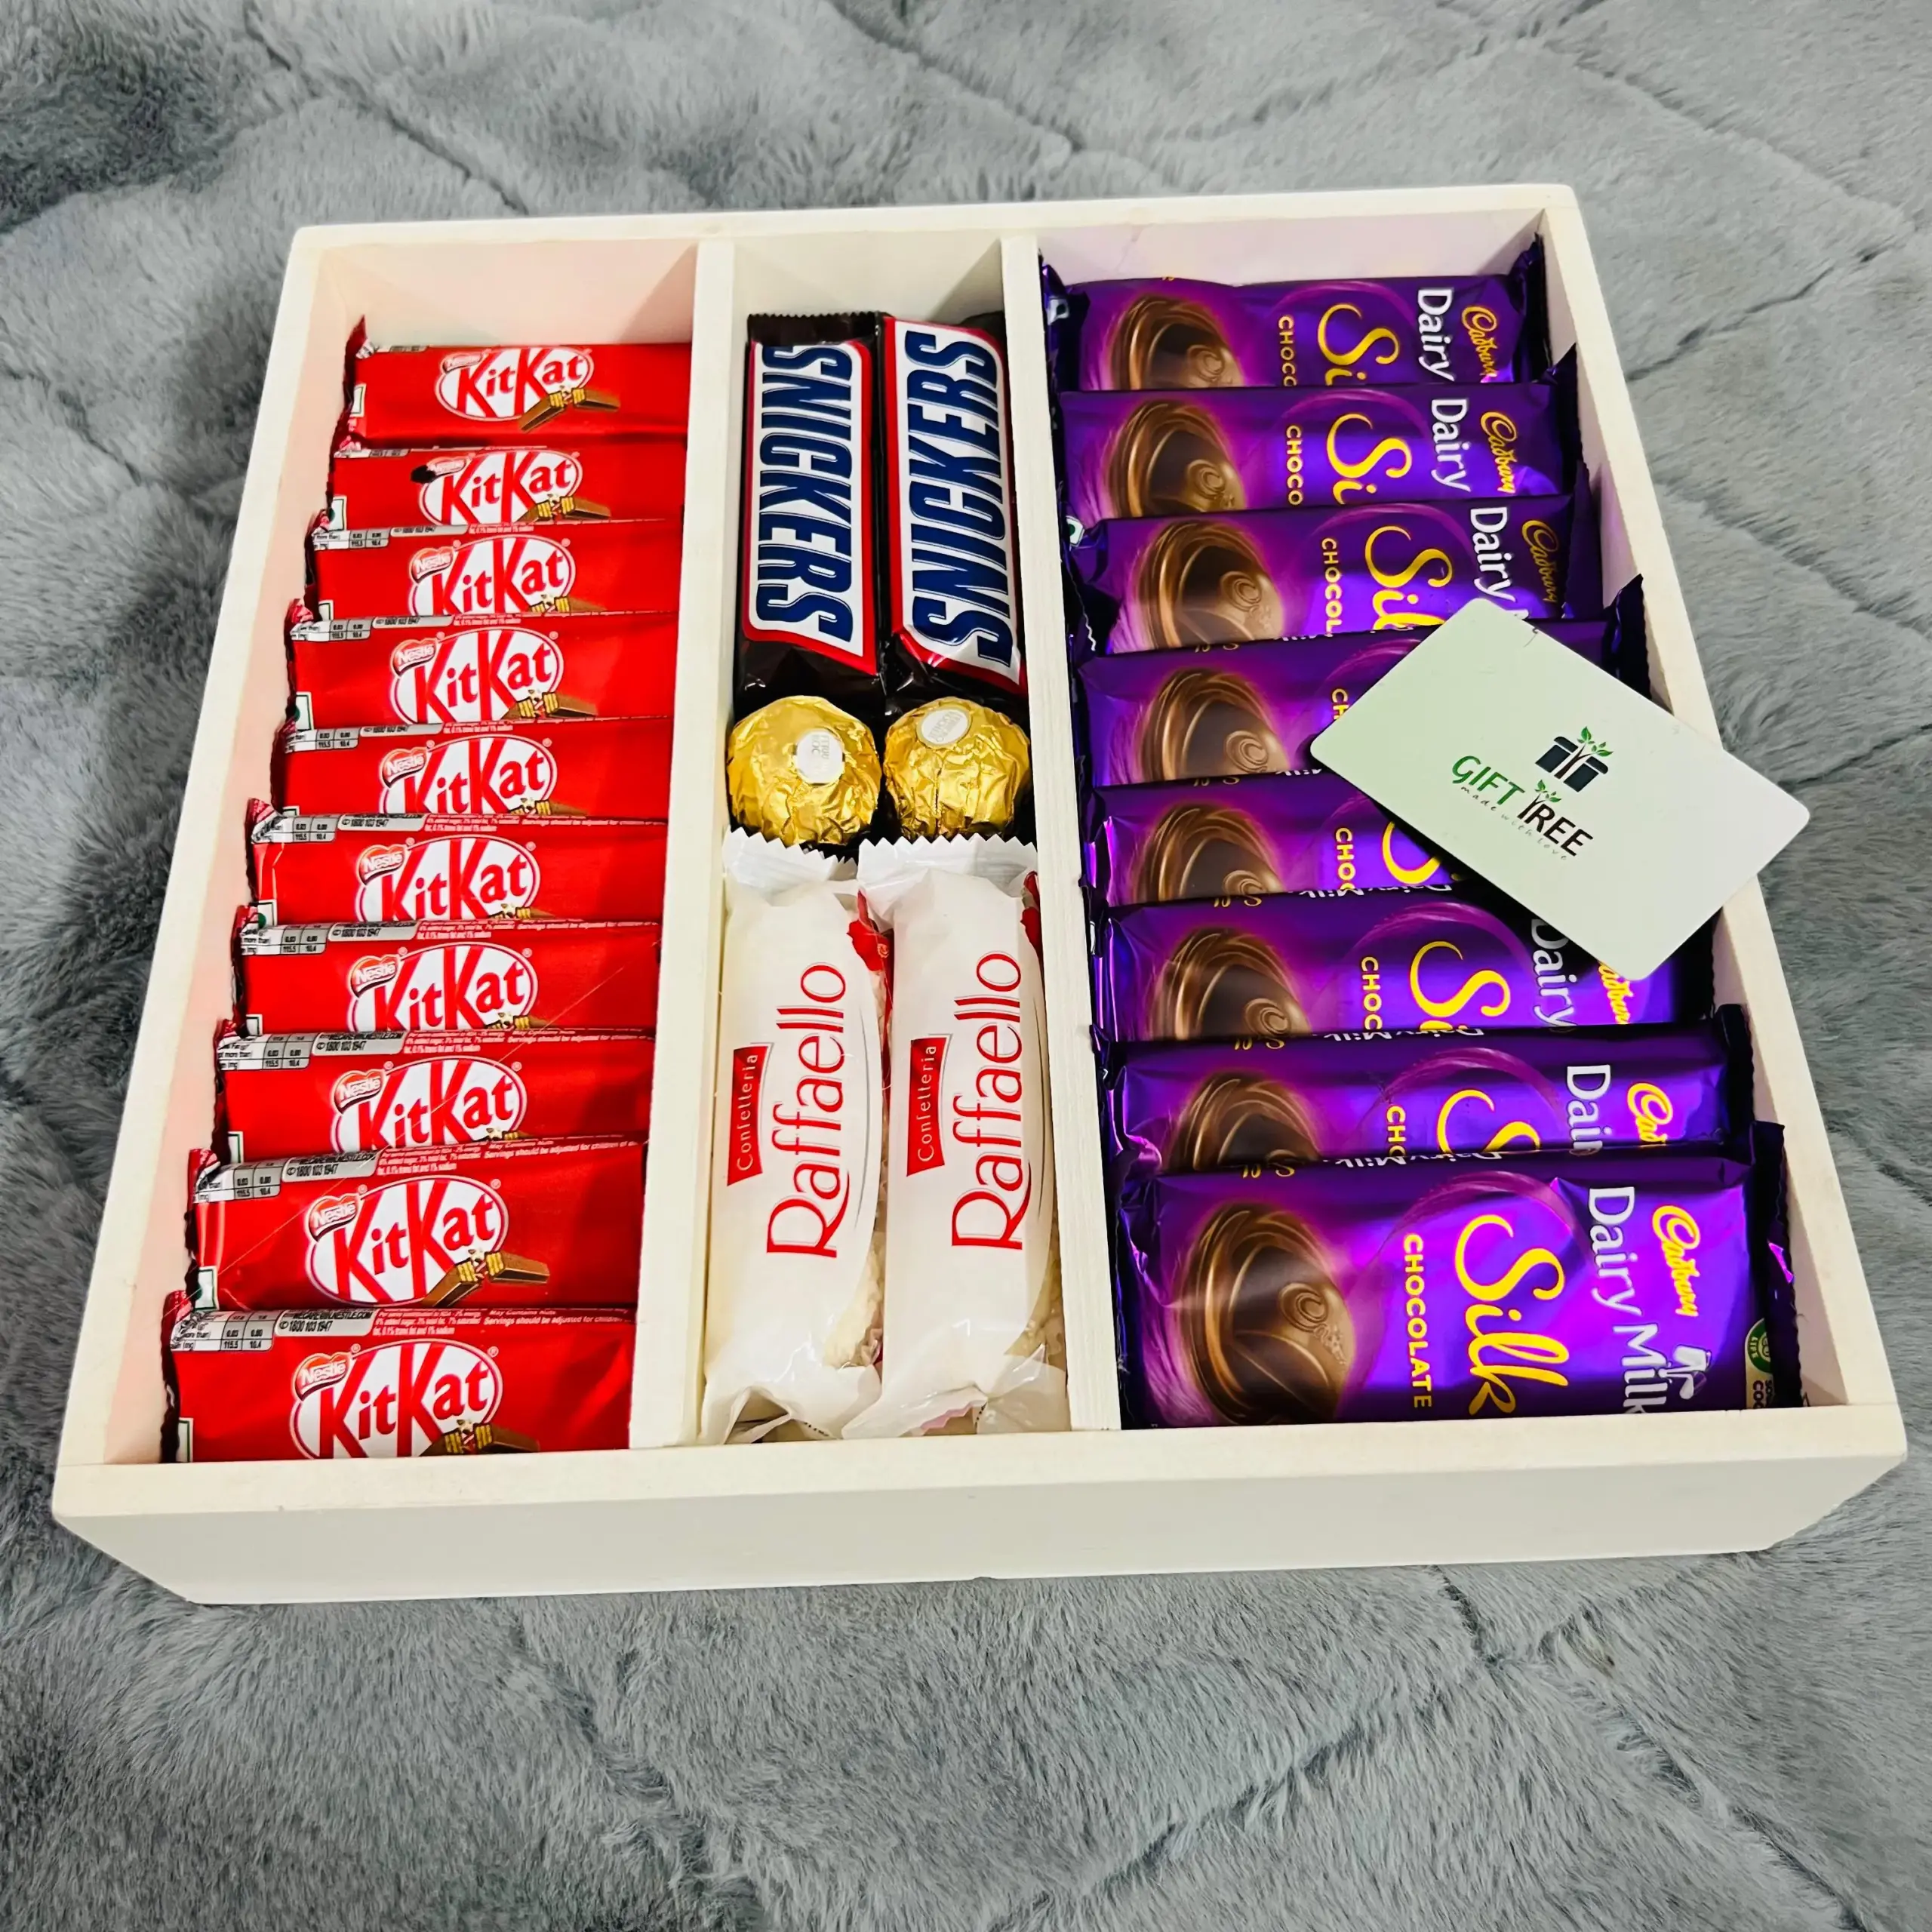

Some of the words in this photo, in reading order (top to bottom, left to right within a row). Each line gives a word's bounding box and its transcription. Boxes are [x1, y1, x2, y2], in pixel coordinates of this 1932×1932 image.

[1417, 288, 1456, 381] Dairy
[1462, 306, 1498, 377] Cadbury
[456, 347, 584, 417] KitKat
[441, 451, 571, 525] KitKat
[1286, 425, 1303, 506] CHOCO
[1327, 413, 1412, 505] Si
[1431, 398, 1472, 492] Dairy
[1480, 411, 1517, 494] Cadbury
[755, 344, 853, 643] SNICKERS
[905, 329, 1014, 669] SNICKERS
[432, 537, 564, 614] KitKat
[1469, 506, 1515, 602] Dairy
[1521, 520, 1559, 604] Cadbury
[414, 629, 552, 722] KitKat
[404, 738, 545, 814] KitKat
[1452, 755, 1526, 805] GIFT
[1517, 780, 1594, 857] TREE
[1460, 786, 1497, 811] made
[381, 837, 528, 921] KitKat
[374, 946, 525, 1031] KitKat
[1531, 918, 1578, 1027] Dairy
[358, 1059, 514, 1149] KitKat
[737, 1054, 758, 1174] Confetteria
[766, 963, 851, 1258] Raffaello
[917, 1045, 937, 1162] Confetteria
[952, 952, 1032, 1251] Raffaello
[333, 1180, 496, 1303] KitKat
[1587, 1186, 1643, 1316] Dairy
[1652, 1204, 1701, 1318] Cadbury
[1403, 1233, 1432, 1408] CHOCOLATE
[1454, 1214, 1569, 1416] Silk
[319, 1342, 491, 1458] KitKat
[1613, 1323, 1672, 1414] Milk
